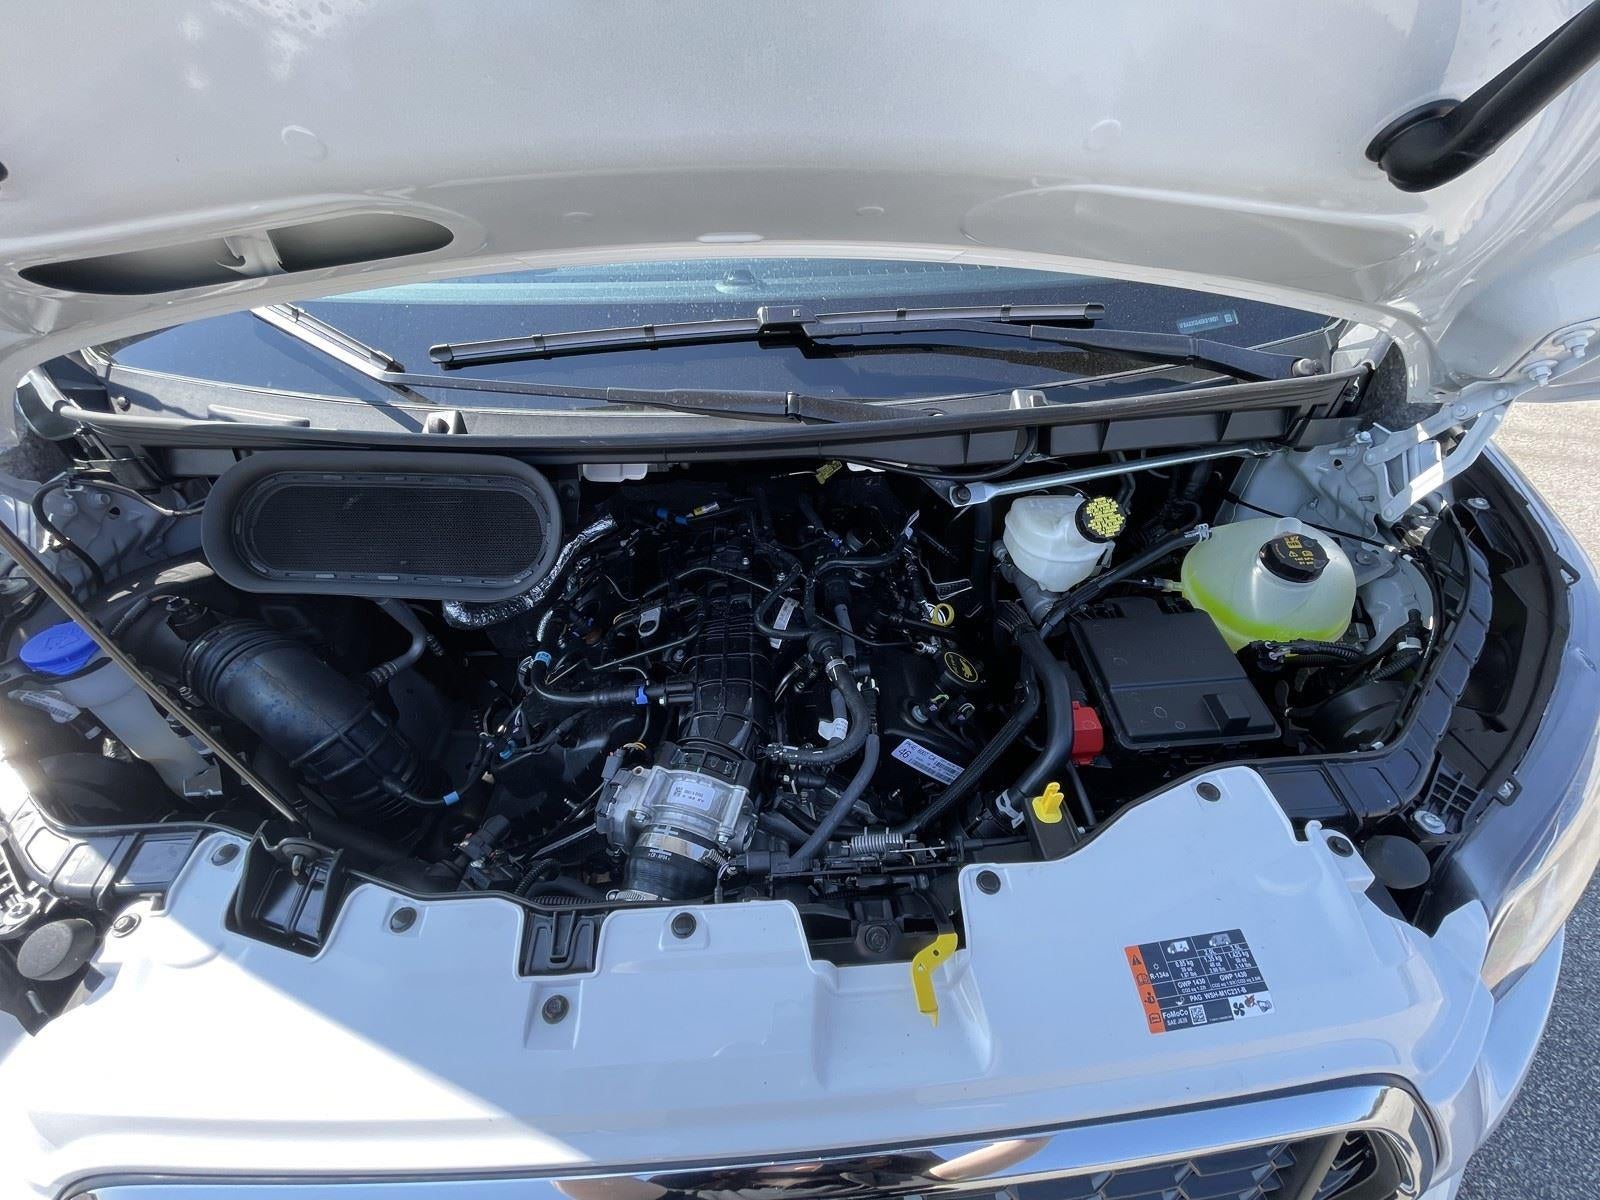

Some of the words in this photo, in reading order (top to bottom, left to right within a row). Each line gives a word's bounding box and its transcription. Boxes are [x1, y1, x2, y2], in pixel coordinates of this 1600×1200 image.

[899, 748, 911, 758] 46
[1234, 971, 1247, 979] 1430
[1178, 980, 1192, 989] GWP
[1192, 978, 1206, 986] 1430
[1189, 994, 1202, 1002] PAG
[1204, 987, 1247, 1000] WSH-M1C231-B
[1163, 1009, 1188, 1019] FoMoCo
